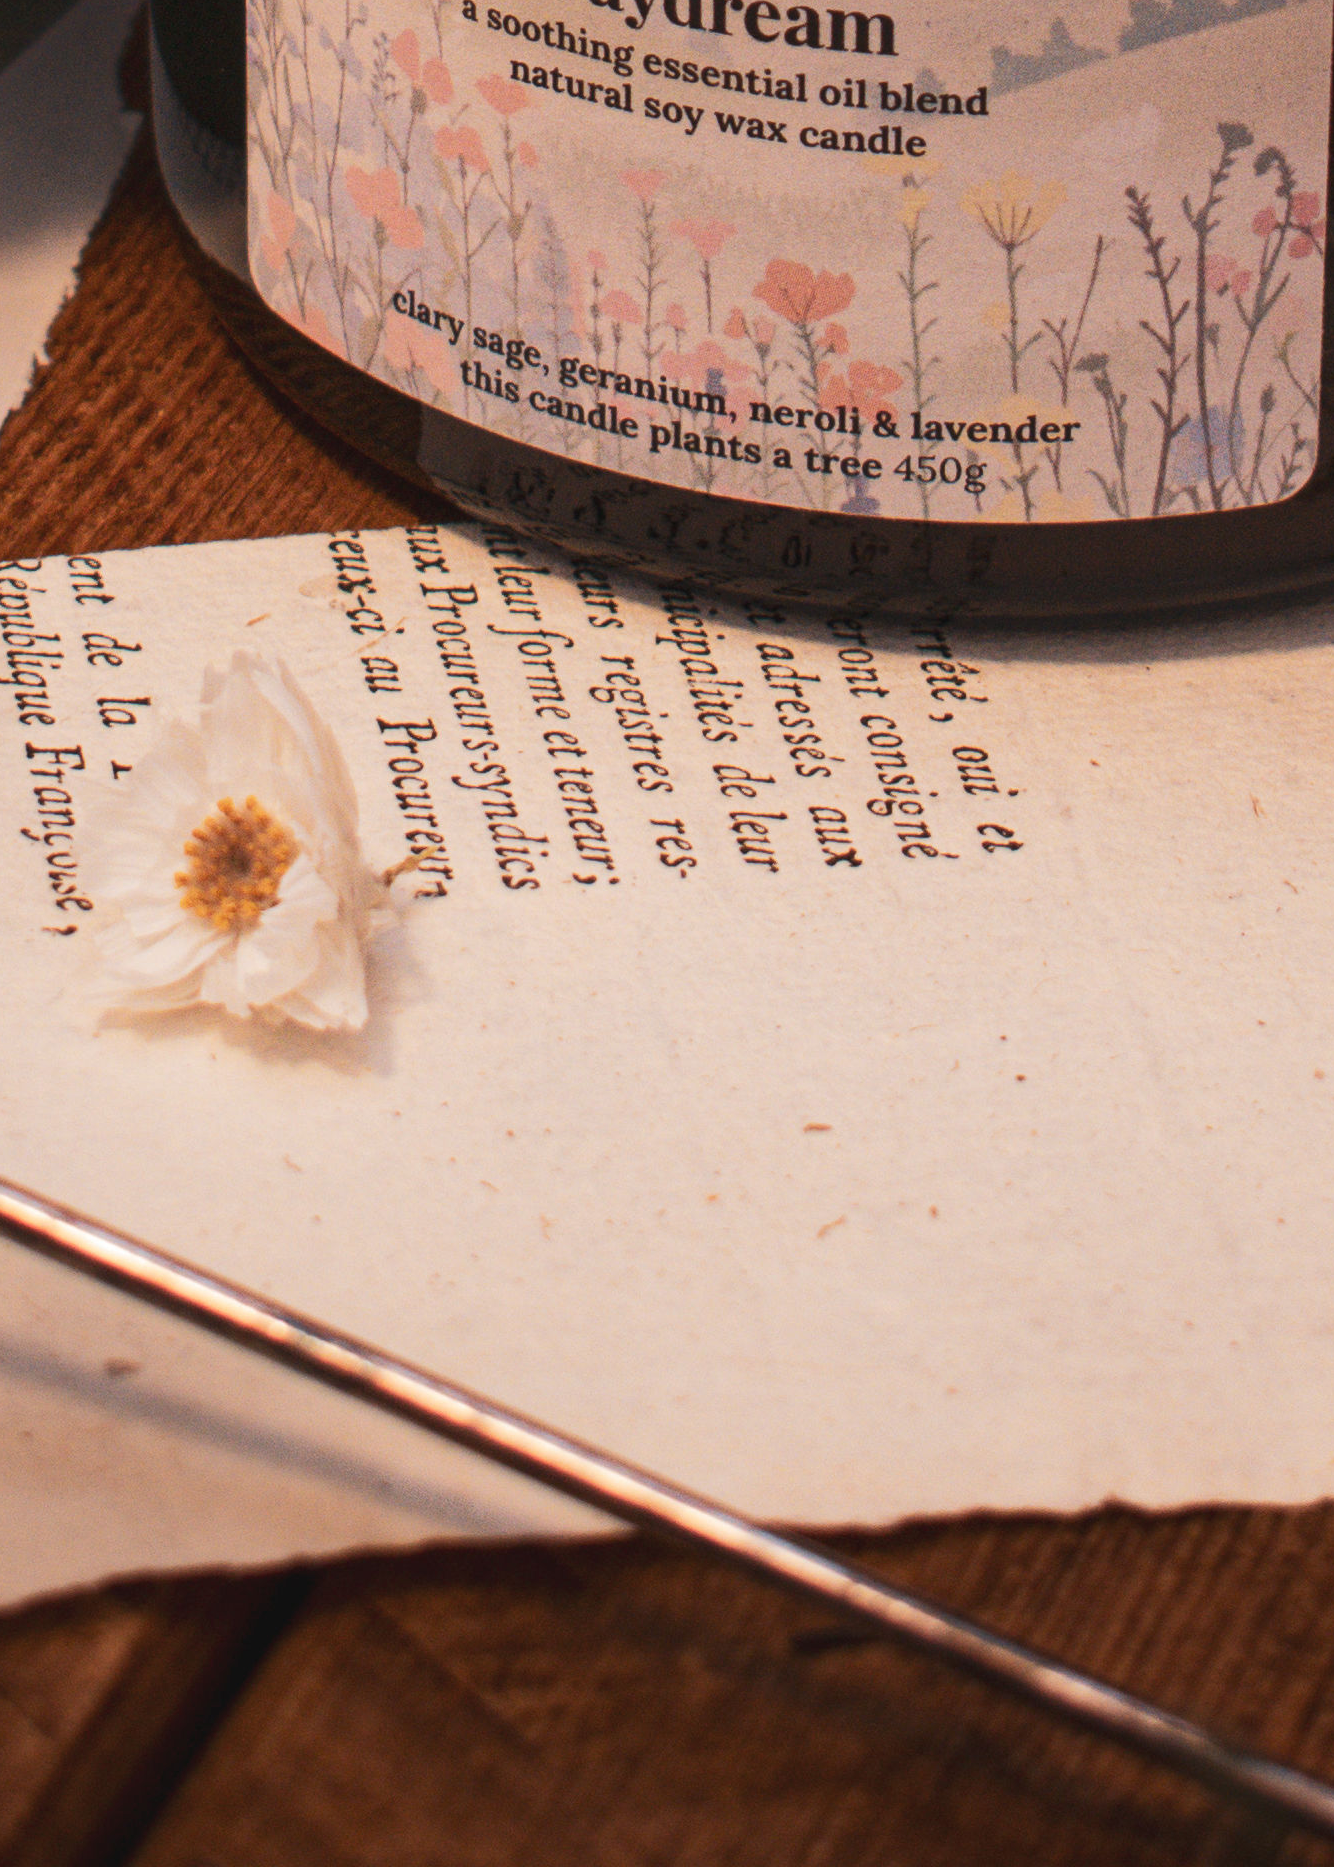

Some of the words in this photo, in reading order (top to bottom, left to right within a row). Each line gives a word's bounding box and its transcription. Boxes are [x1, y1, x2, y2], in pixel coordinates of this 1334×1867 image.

[486, 4, 635, 76] soothing
[643, 49, 807, 103] essential
[819, 78, 868, 109] oil
[879, 81, 989, 117] blend
[509, 58, 633, 112] natural
[643, 97, 704, 135] soy
[714, 111, 787, 143] wax
[799, 123, 927, 157] candle
[392, 285, 464, 345] clary
[472, 324, 550, 375] sage,
[559, 353, 737, 423] geranium,
[749, 397, 861, 436] neroli
[872, 411, 901, 439] &
[910, 410, 1080, 443] lavender
[459, 357, 520, 403] this
[529, 387, 639, 439] candle
[650, 421, 761, 466] plants
[772, 444, 793, 468] a
[805, 446, 883, 480] tree
[893, 455, 986, 493] 450g
[491, 565, 551, 622] leur
[79, 631, 144, 668] de
[358, 655, 404, 695] au
[484, 622, 575, 721] forme
[94, 695, 153, 729] la
[417, 581, 551, 891] Procureurs-syndics
[541, 729, 588, 759] et
[753, 641, 847, 779] adressés
[806, 804, 864, 869] aux
[587, 654, 675, 794] registres
[647, 817, 698, 880] res-
[711, 763, 777, 799] de
[858, 713, 961, 861] consigné
[950, 744, 1020, 798] oui
[551, 765, 621, 886] teneur;
[727, 810, 789, 875] leur
[974, 822, 1025, 854] et
